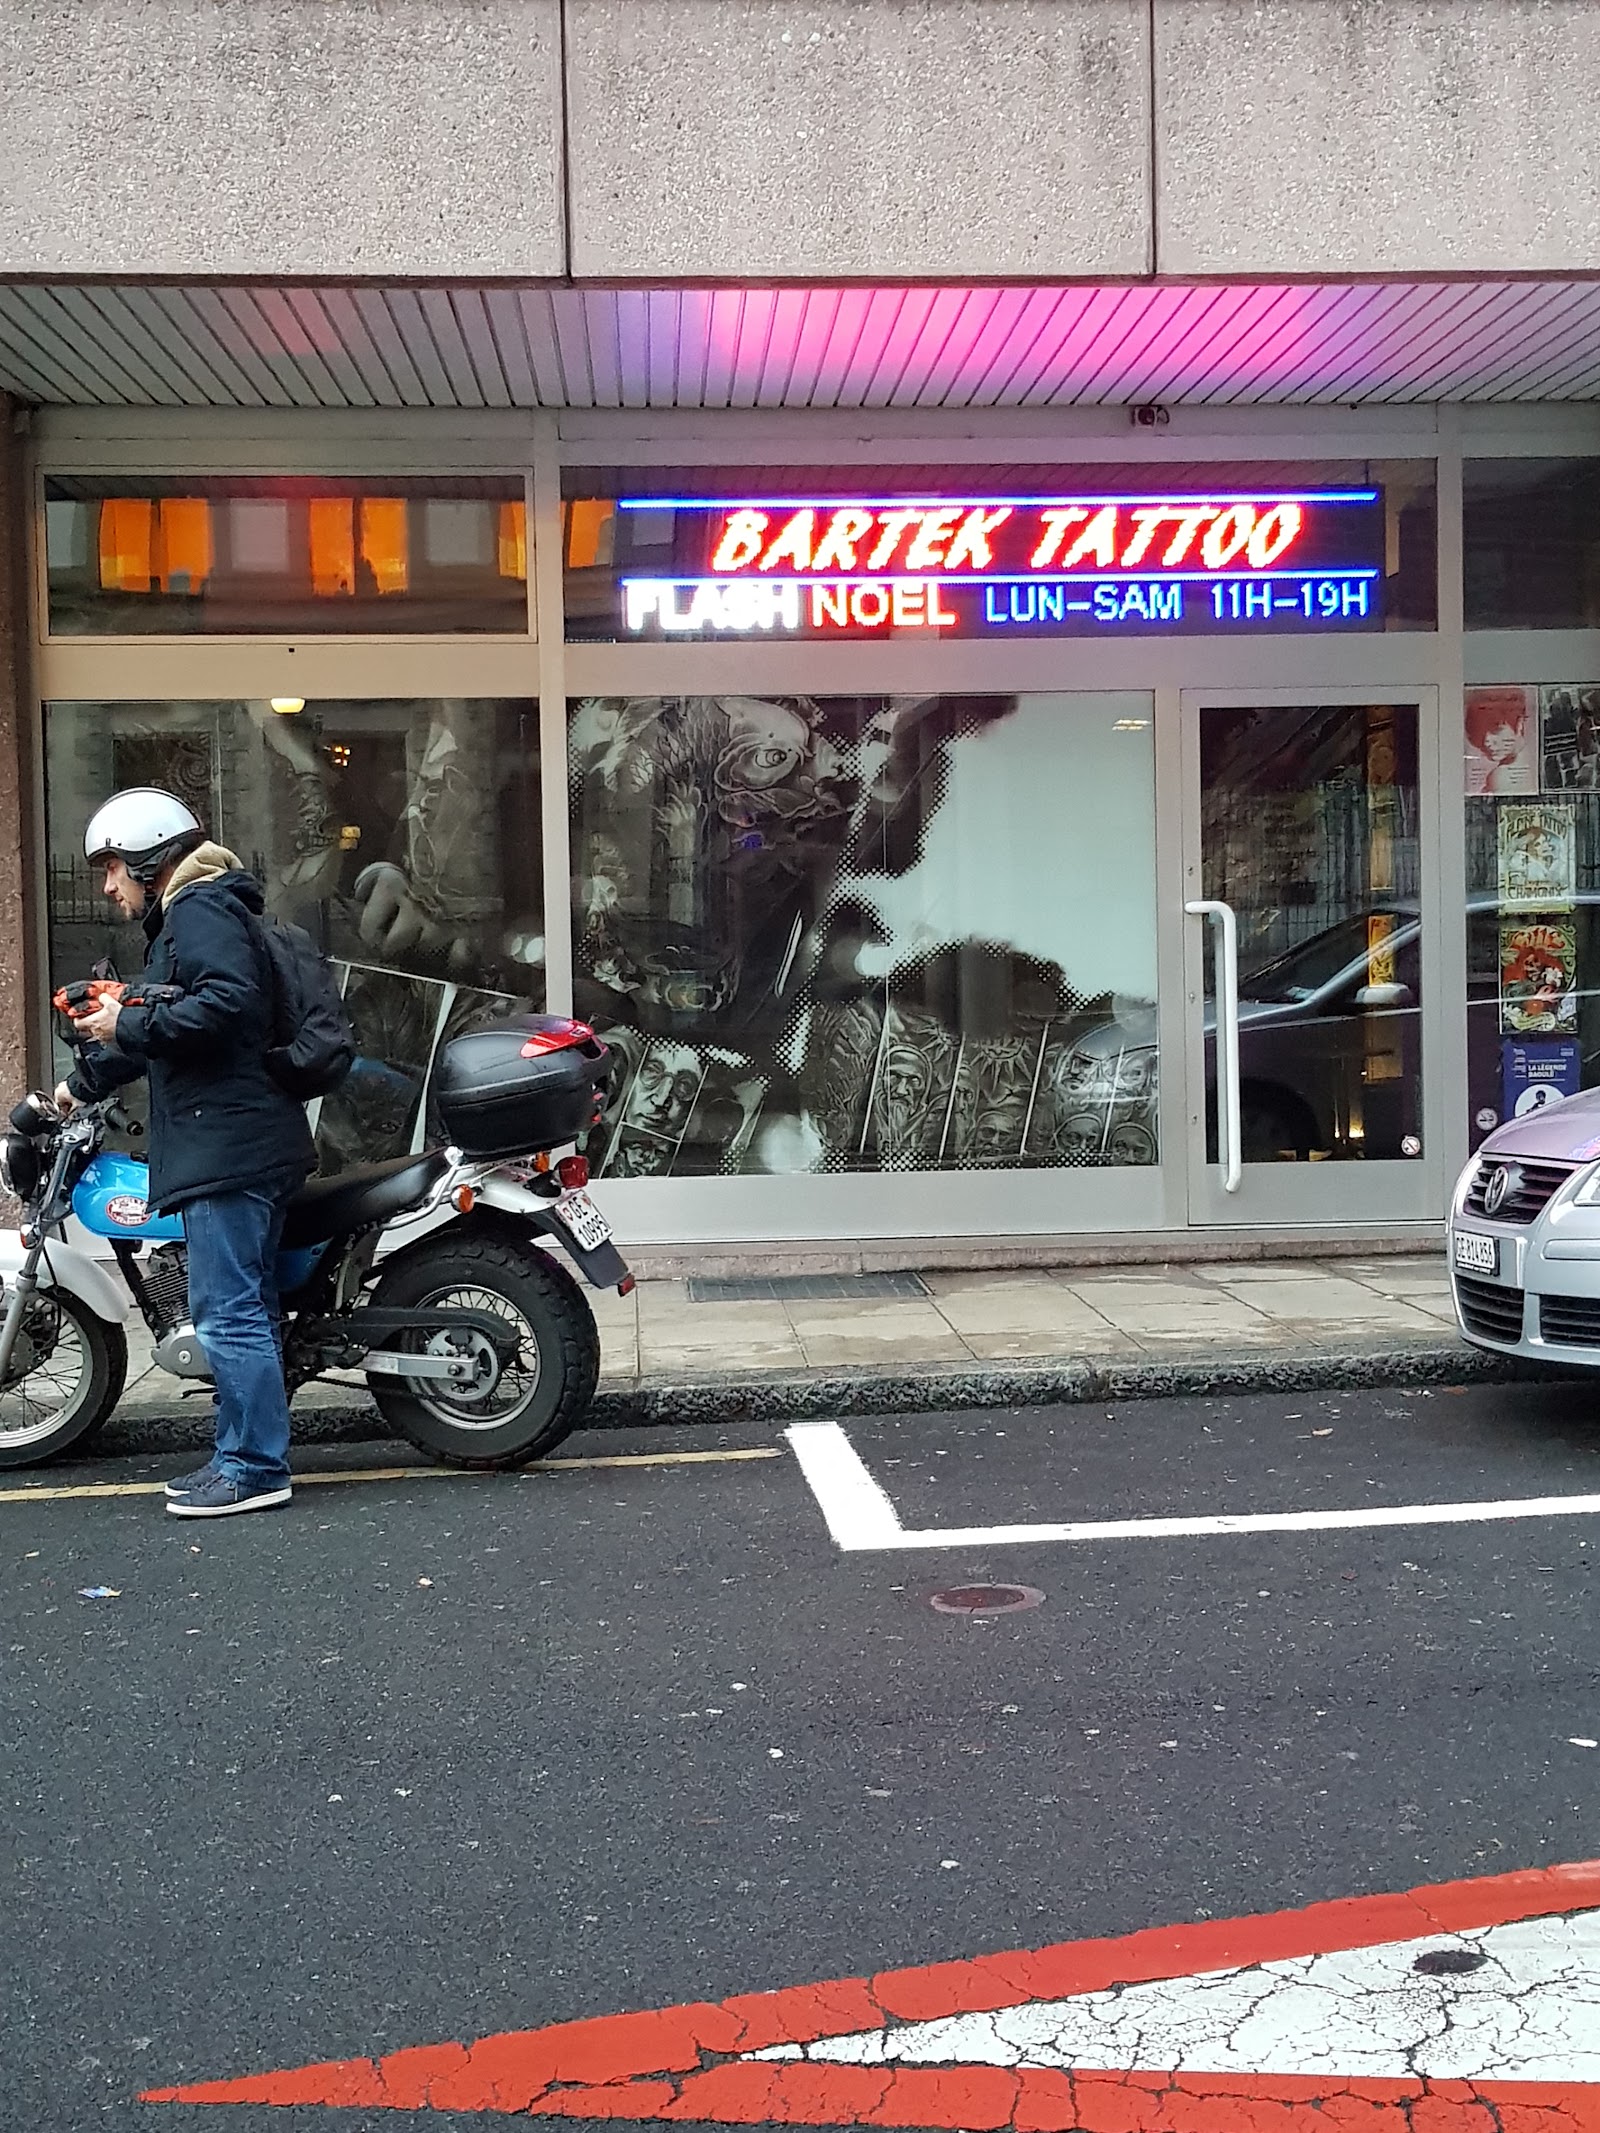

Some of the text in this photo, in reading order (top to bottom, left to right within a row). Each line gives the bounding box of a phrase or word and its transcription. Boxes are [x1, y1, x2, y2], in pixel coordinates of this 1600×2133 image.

[712, 503, 1302, 572] BARTEK TATTOO
[811, 582, 957, 628] NOEL
[984, 582, 1183, 623] LUN-SAM
[1210, 578, 1370, 620] 11H-19H
[568, 1196, 588, 1219] GE
